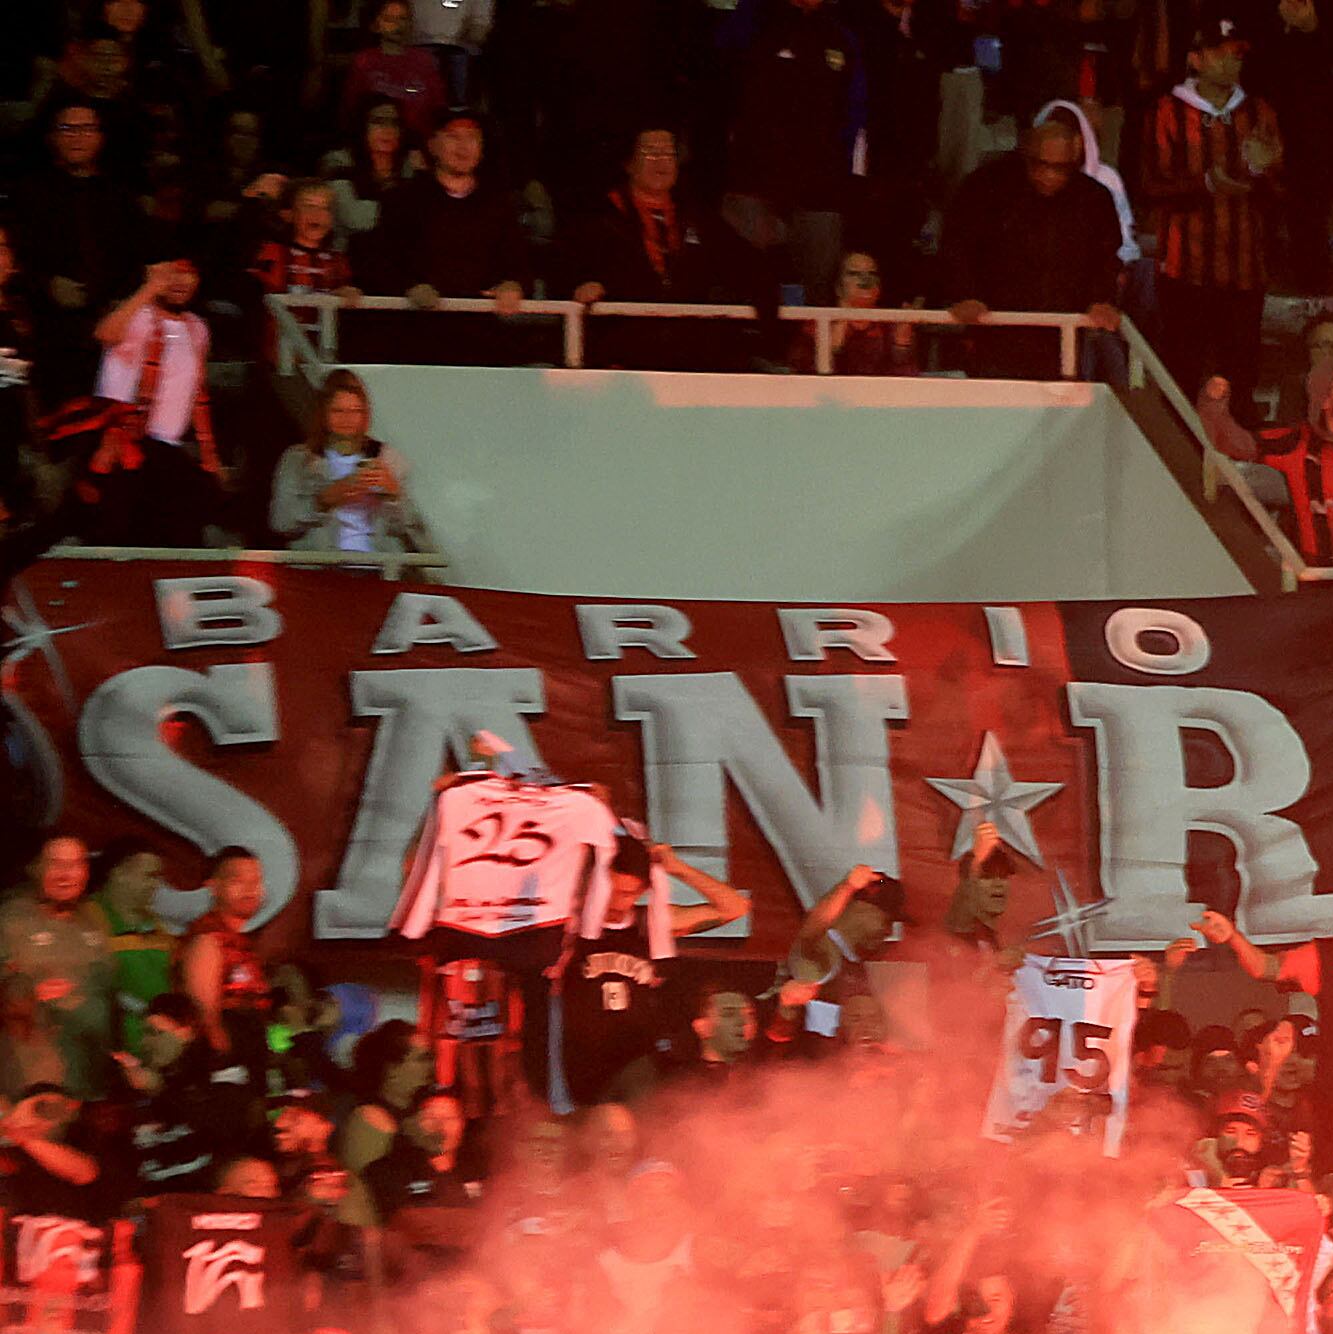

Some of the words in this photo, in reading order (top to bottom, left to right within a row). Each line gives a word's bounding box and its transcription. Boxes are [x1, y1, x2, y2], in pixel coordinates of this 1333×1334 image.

[154, 576, 1211, 675] BARRIO
[78, 662, 909, 942] SAN
[1018, 1016, 1113, 1090] 95
